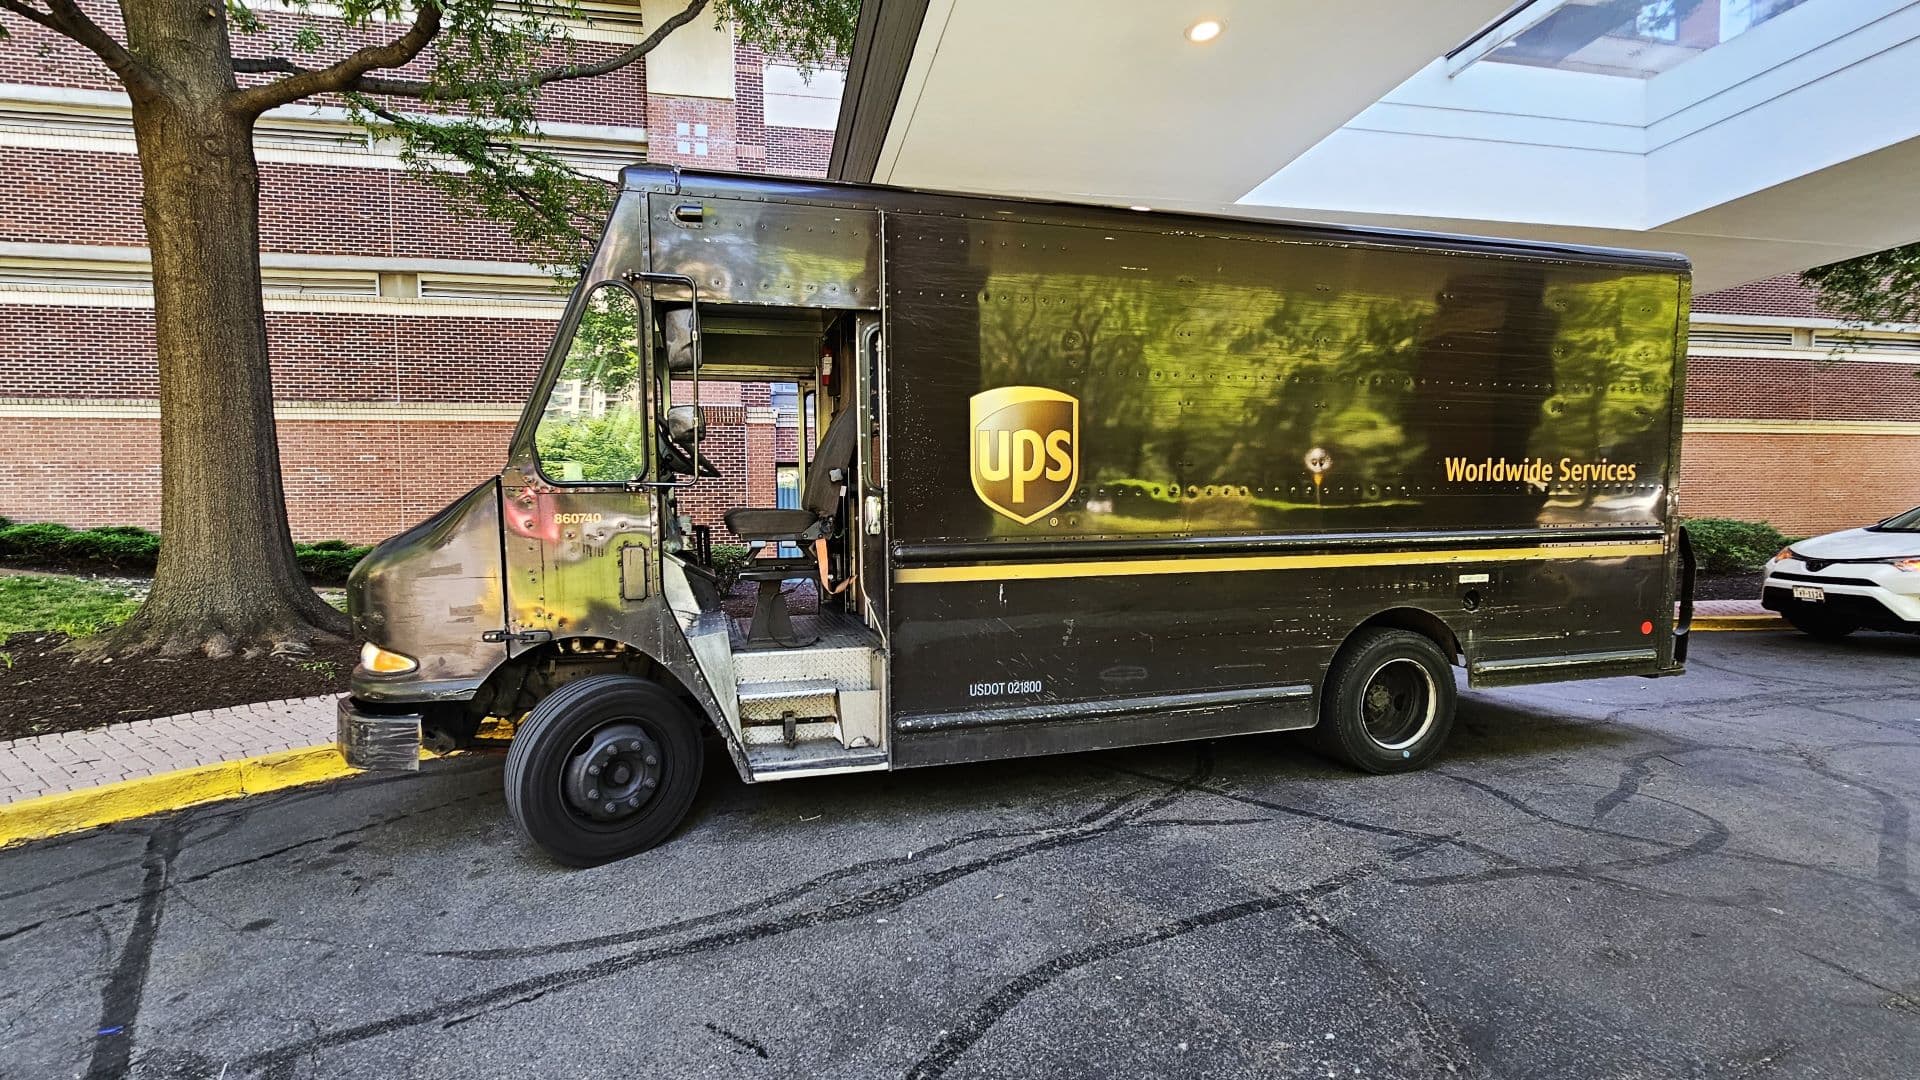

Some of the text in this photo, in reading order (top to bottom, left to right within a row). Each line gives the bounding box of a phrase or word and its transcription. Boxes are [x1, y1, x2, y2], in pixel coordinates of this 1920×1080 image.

[979, 429, 1072, 503] ups
[1445, 457, 1637, 482] Worldwide Services
[553, 513, 602, 525] 860740
[969, 680, 1042, 697] USDOT 021800
